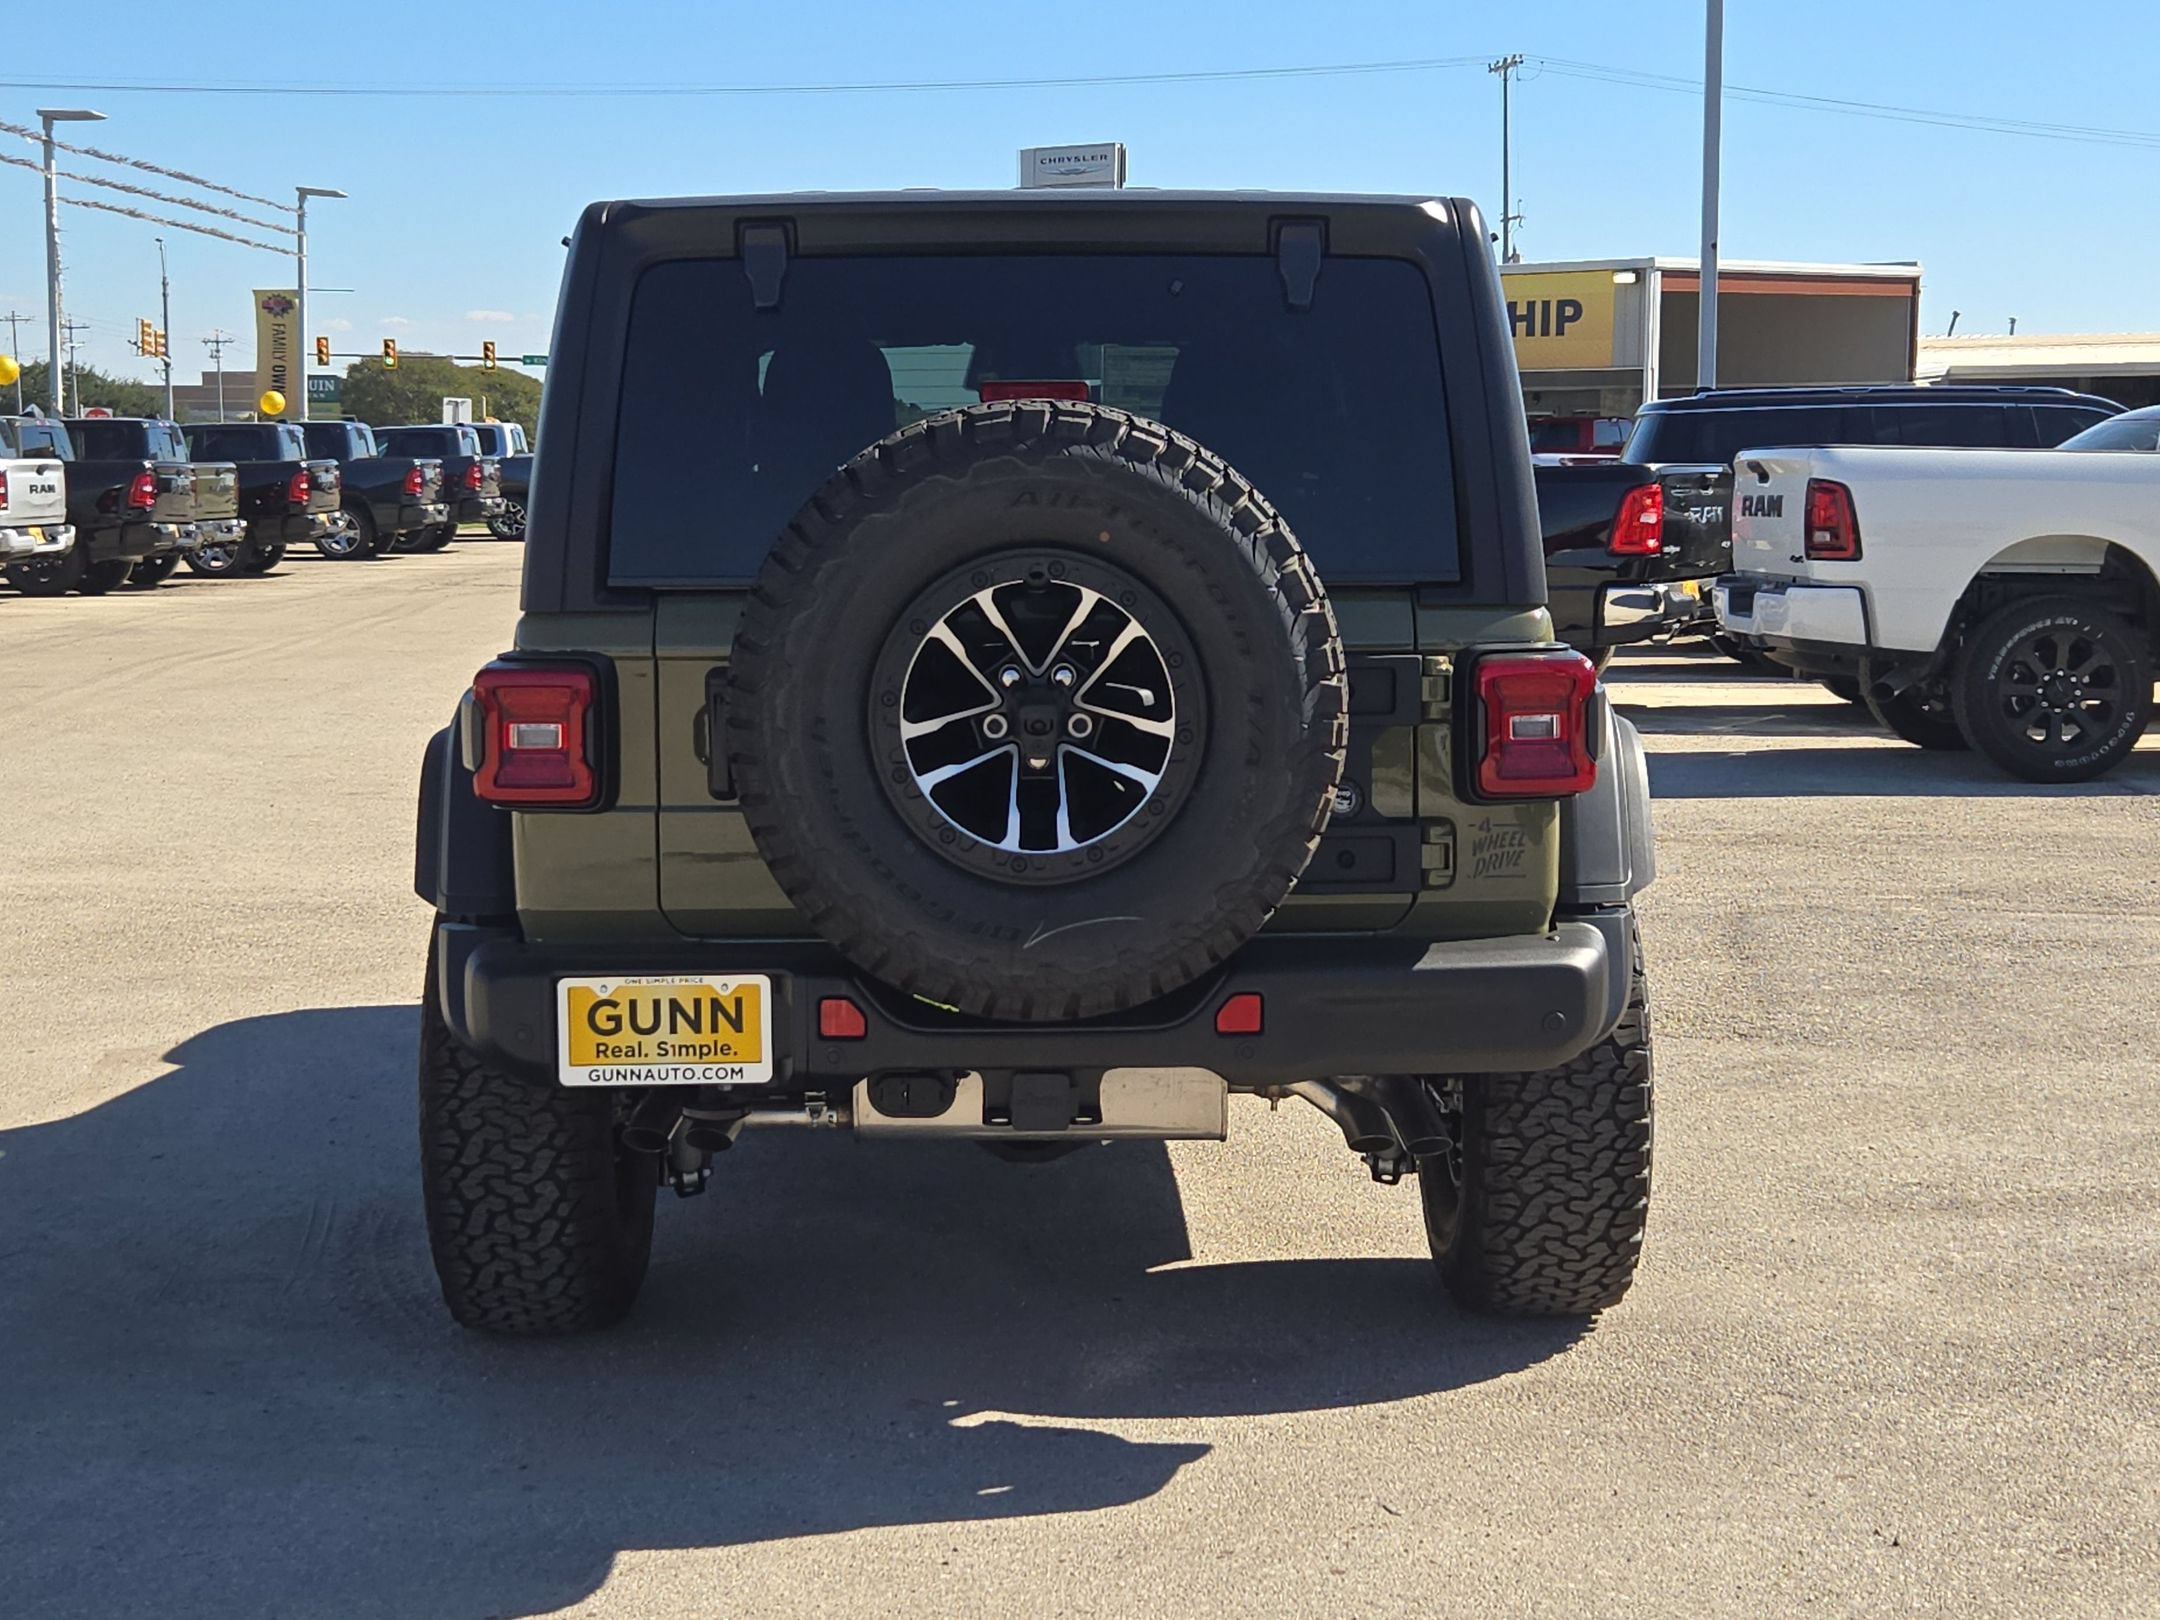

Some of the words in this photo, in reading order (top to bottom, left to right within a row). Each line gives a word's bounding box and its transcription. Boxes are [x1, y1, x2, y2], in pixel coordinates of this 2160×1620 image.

[1040, 154, 1108, 164] CHRYSLER
[1507, 299, 1583, 338] HIP
[271, 323, 287, 362] FAMILY
[29, 484, 56, 494] RAM
[1741, 494, 1784, 518] RAM
[1478, 816, 1492, 833] 4
[1471, 830, 1527, 857] WHEEL
[1472, 849, 1526, 880] DRIVE
[587, 996, 744, 1037] GUNN
[595, 1041, 649, 1059] Real.
[588, 1066, 744, 1083] GUNNAUTO.COM
